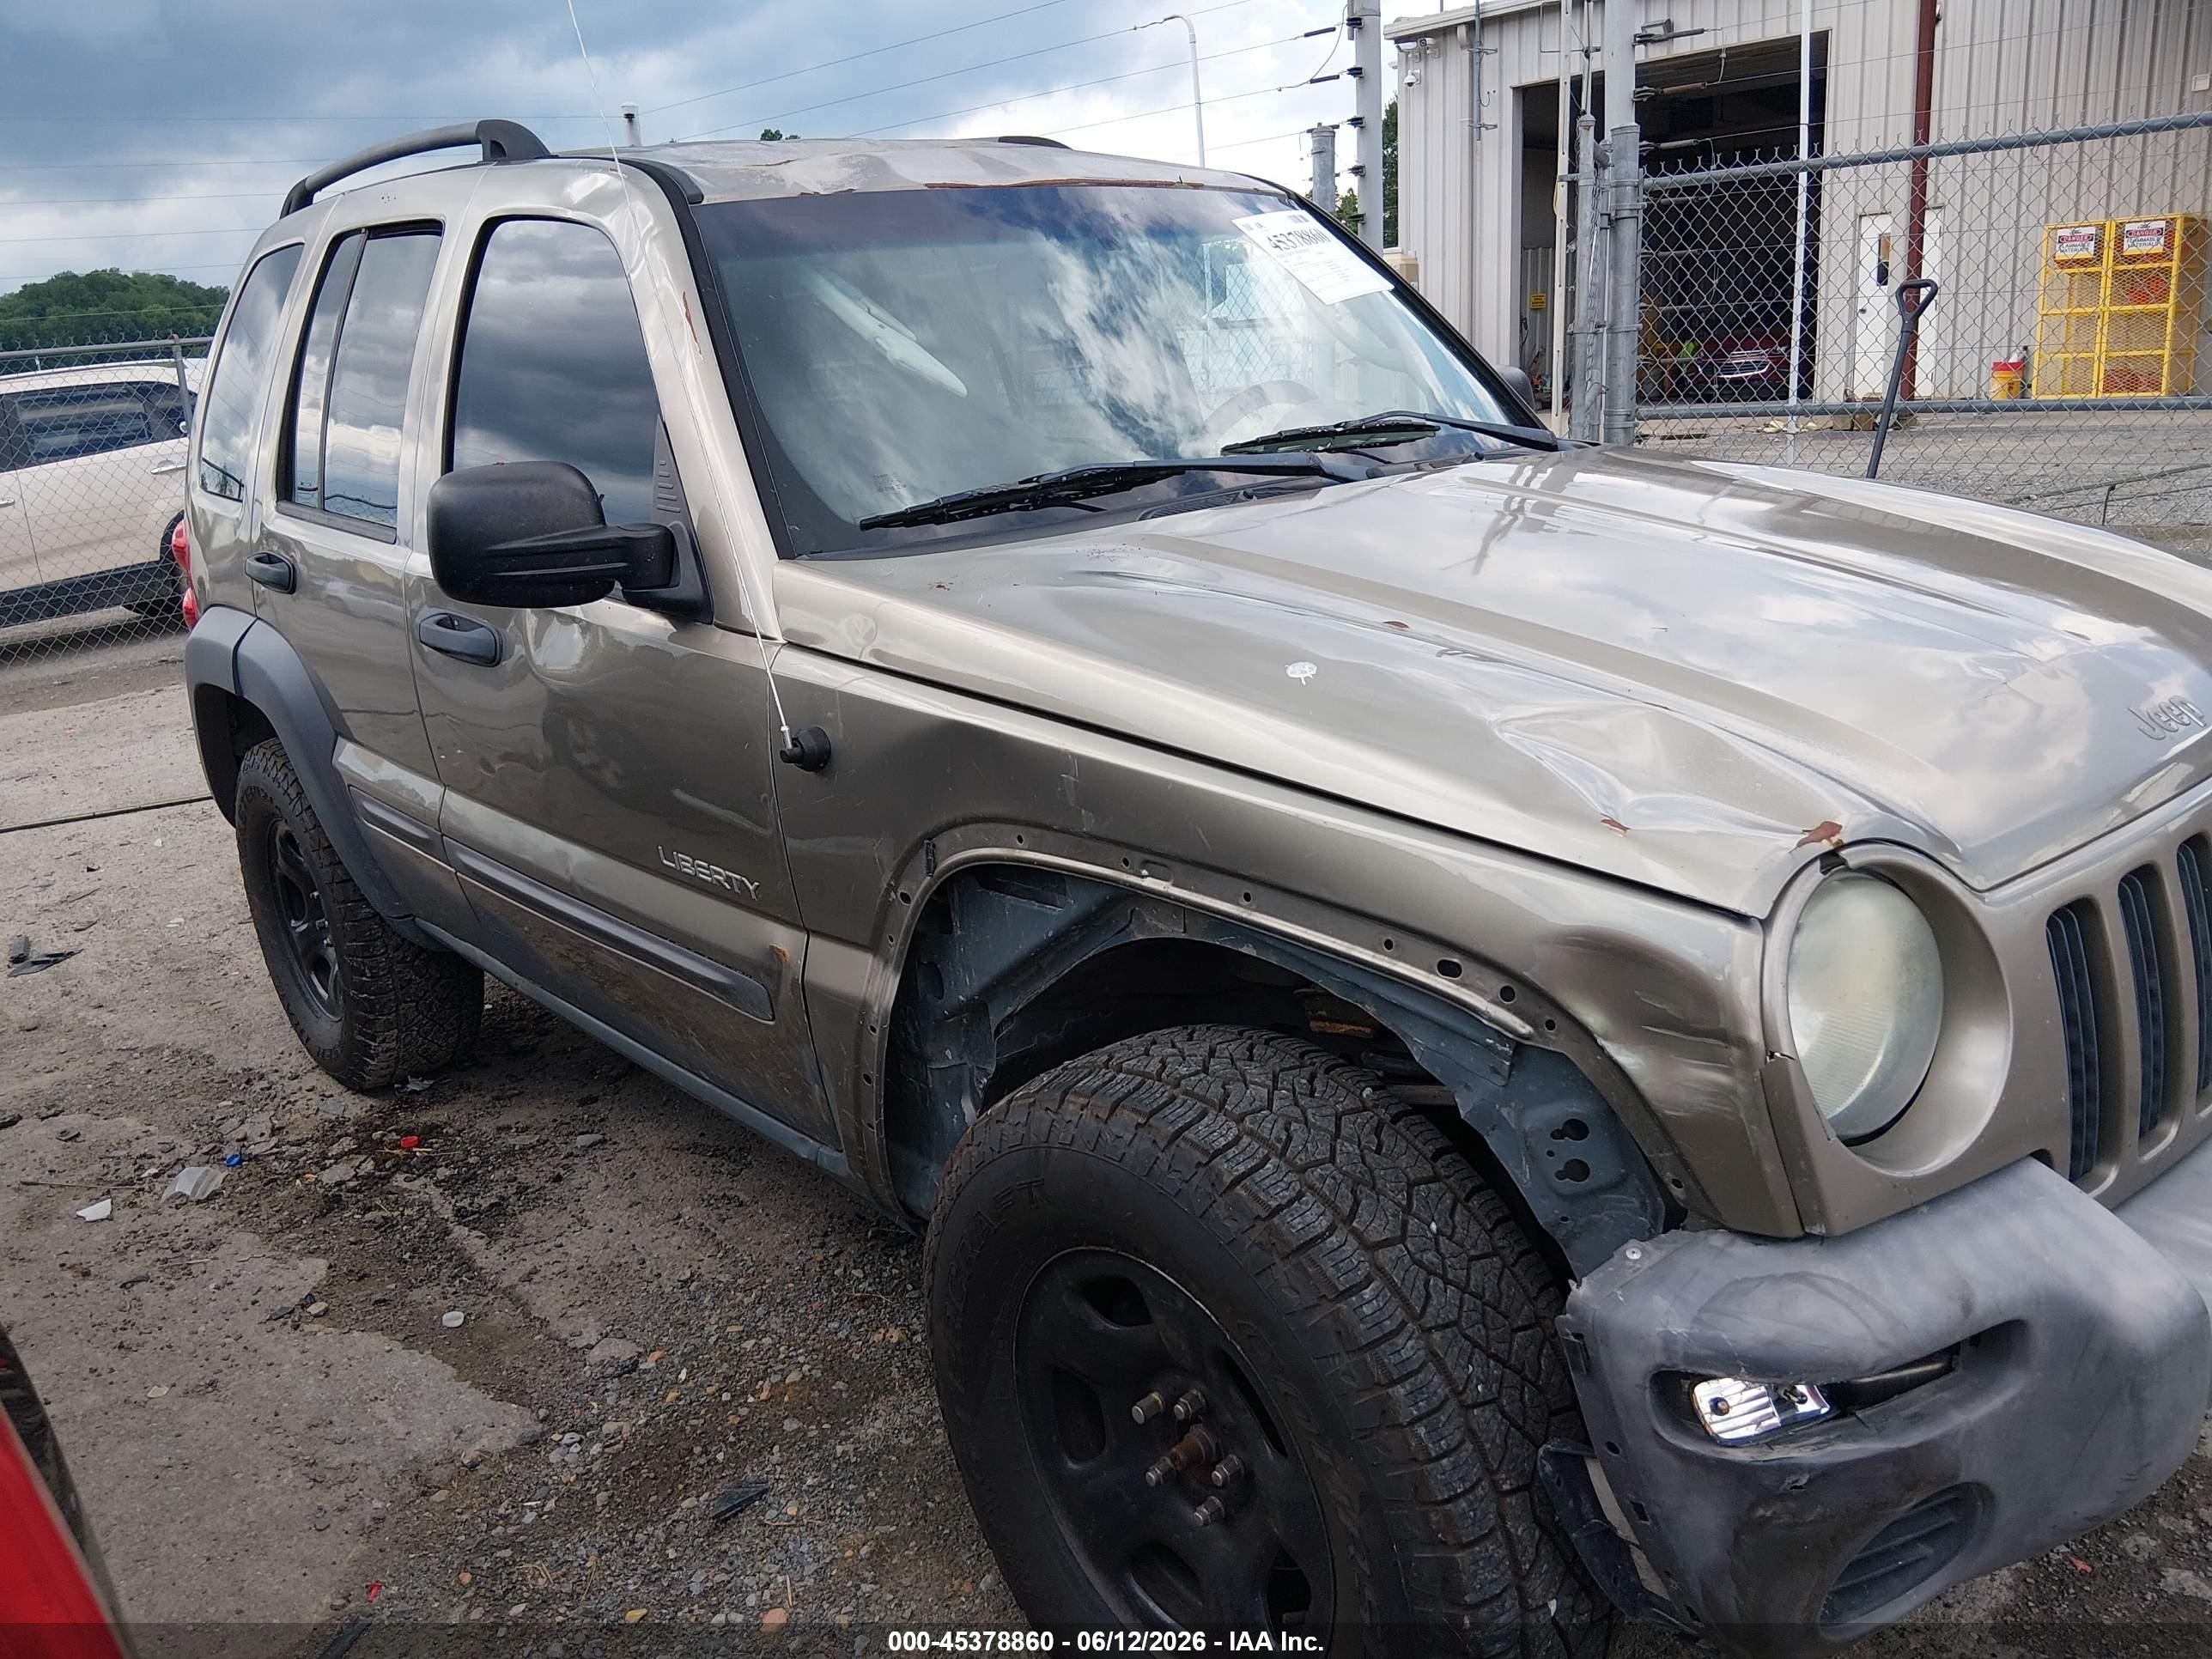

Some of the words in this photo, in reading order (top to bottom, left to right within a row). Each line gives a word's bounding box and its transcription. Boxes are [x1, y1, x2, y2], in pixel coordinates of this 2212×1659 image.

[1267, 227, 1332, 252] 45378860
[2128, 695, 2207, 741] Jeep
[658, 845, 761, 901] LIBERTY
